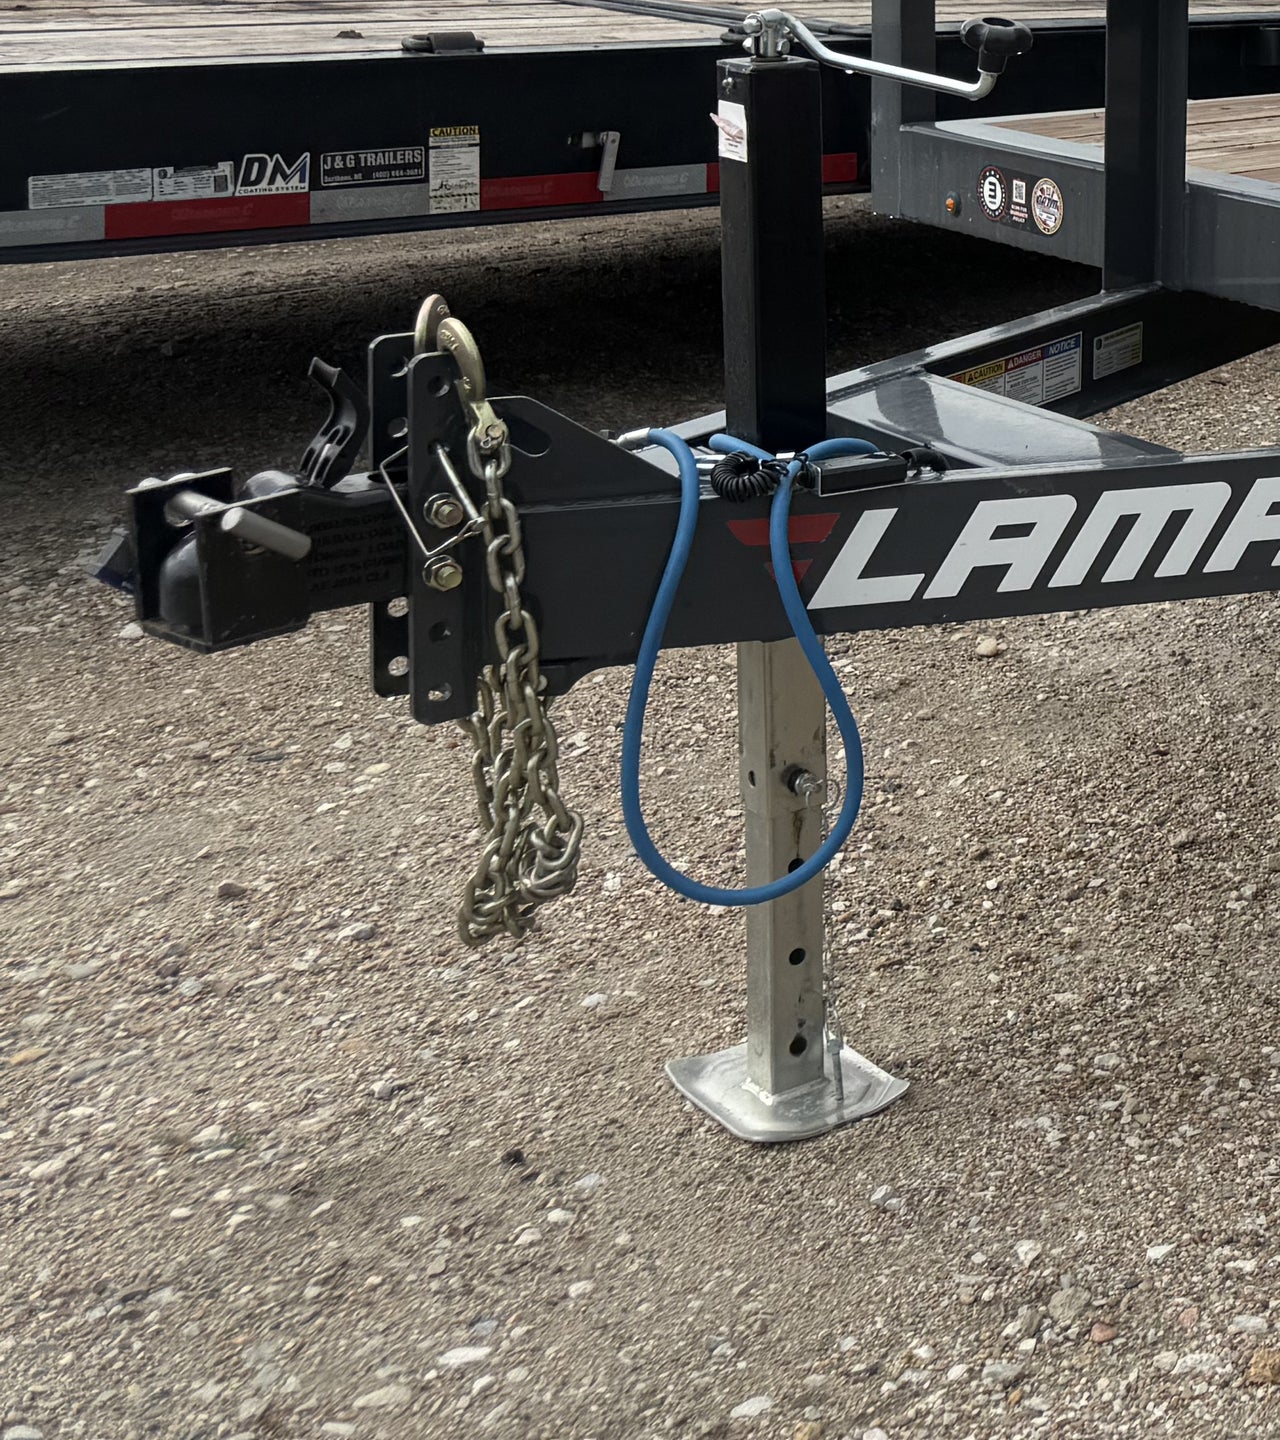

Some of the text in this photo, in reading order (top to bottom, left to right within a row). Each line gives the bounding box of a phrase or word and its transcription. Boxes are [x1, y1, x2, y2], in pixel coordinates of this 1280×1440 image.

[432, 126, 476, 137] CAUTION
[324, 156, 332, 169] J
[334, 155, 344, 169] &
[346, 154, 355, 168] G
[359, 150, 422, 166] TRAILERS
[240, 154, 309, 188] DM
[239, 187, 273, 195] COATING
[1049, 339, 1076, 355] NOTICE
[1013, 350, 1042, 366] DANGER
[974, 362, 1003, 379] CAUTION
